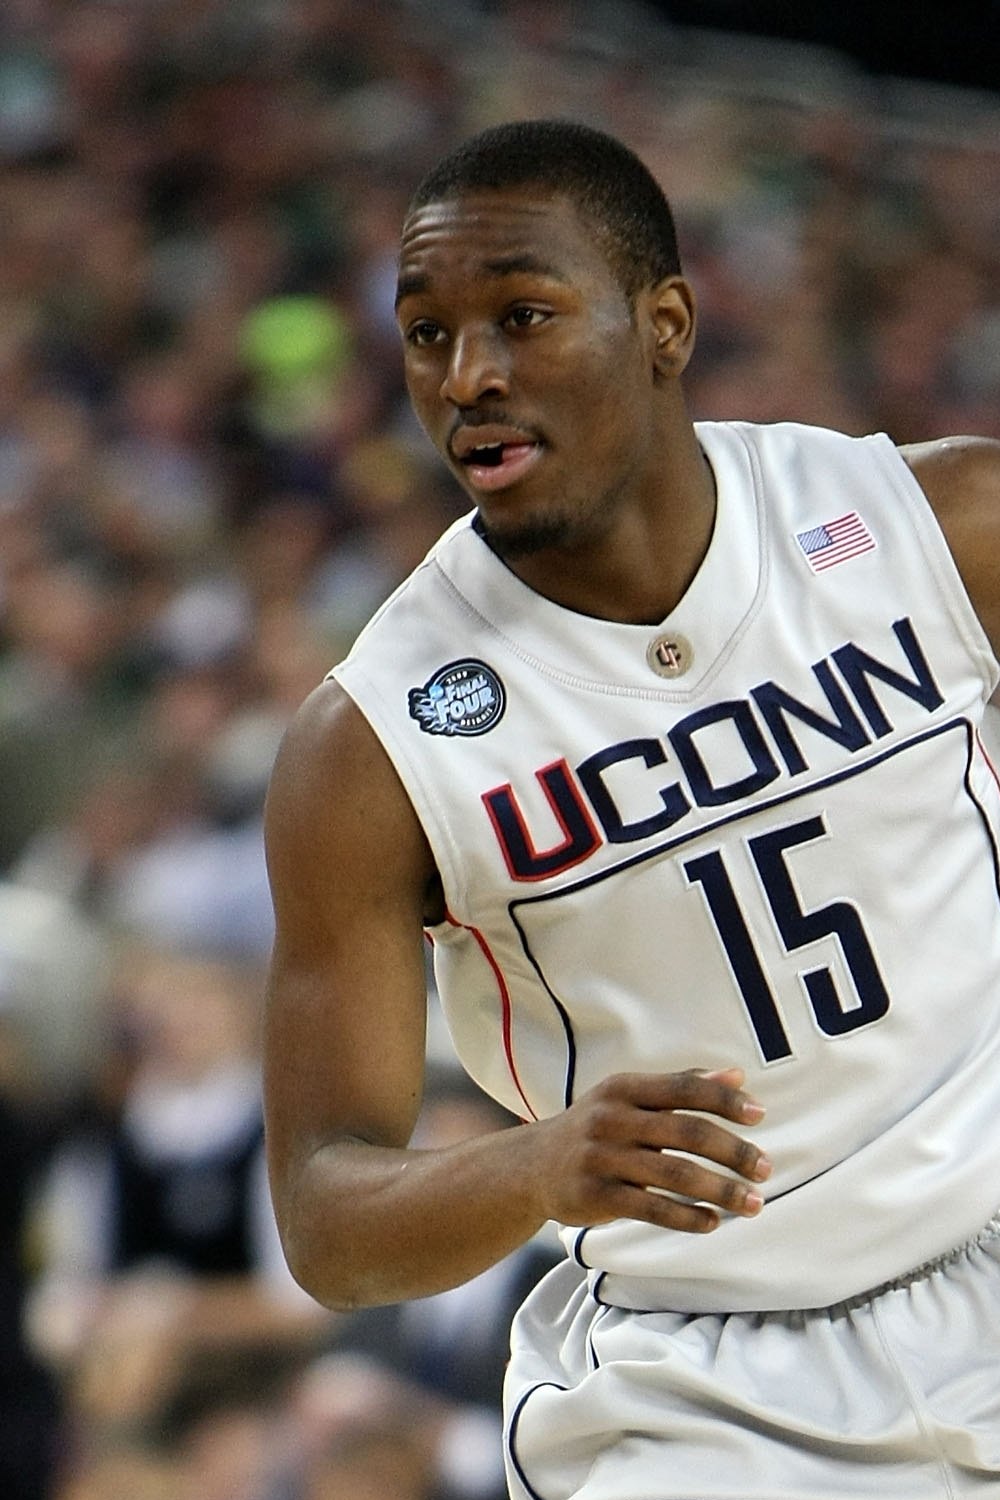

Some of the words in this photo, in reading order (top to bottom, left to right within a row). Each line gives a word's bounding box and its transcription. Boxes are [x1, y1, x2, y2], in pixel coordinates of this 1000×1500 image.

[435, 686, 496, 725] FOUR
[444, 674, 488, 702] FINAL
[482, 616, 945, 883] UCONN
[682, 813, 891, 1065] 15
